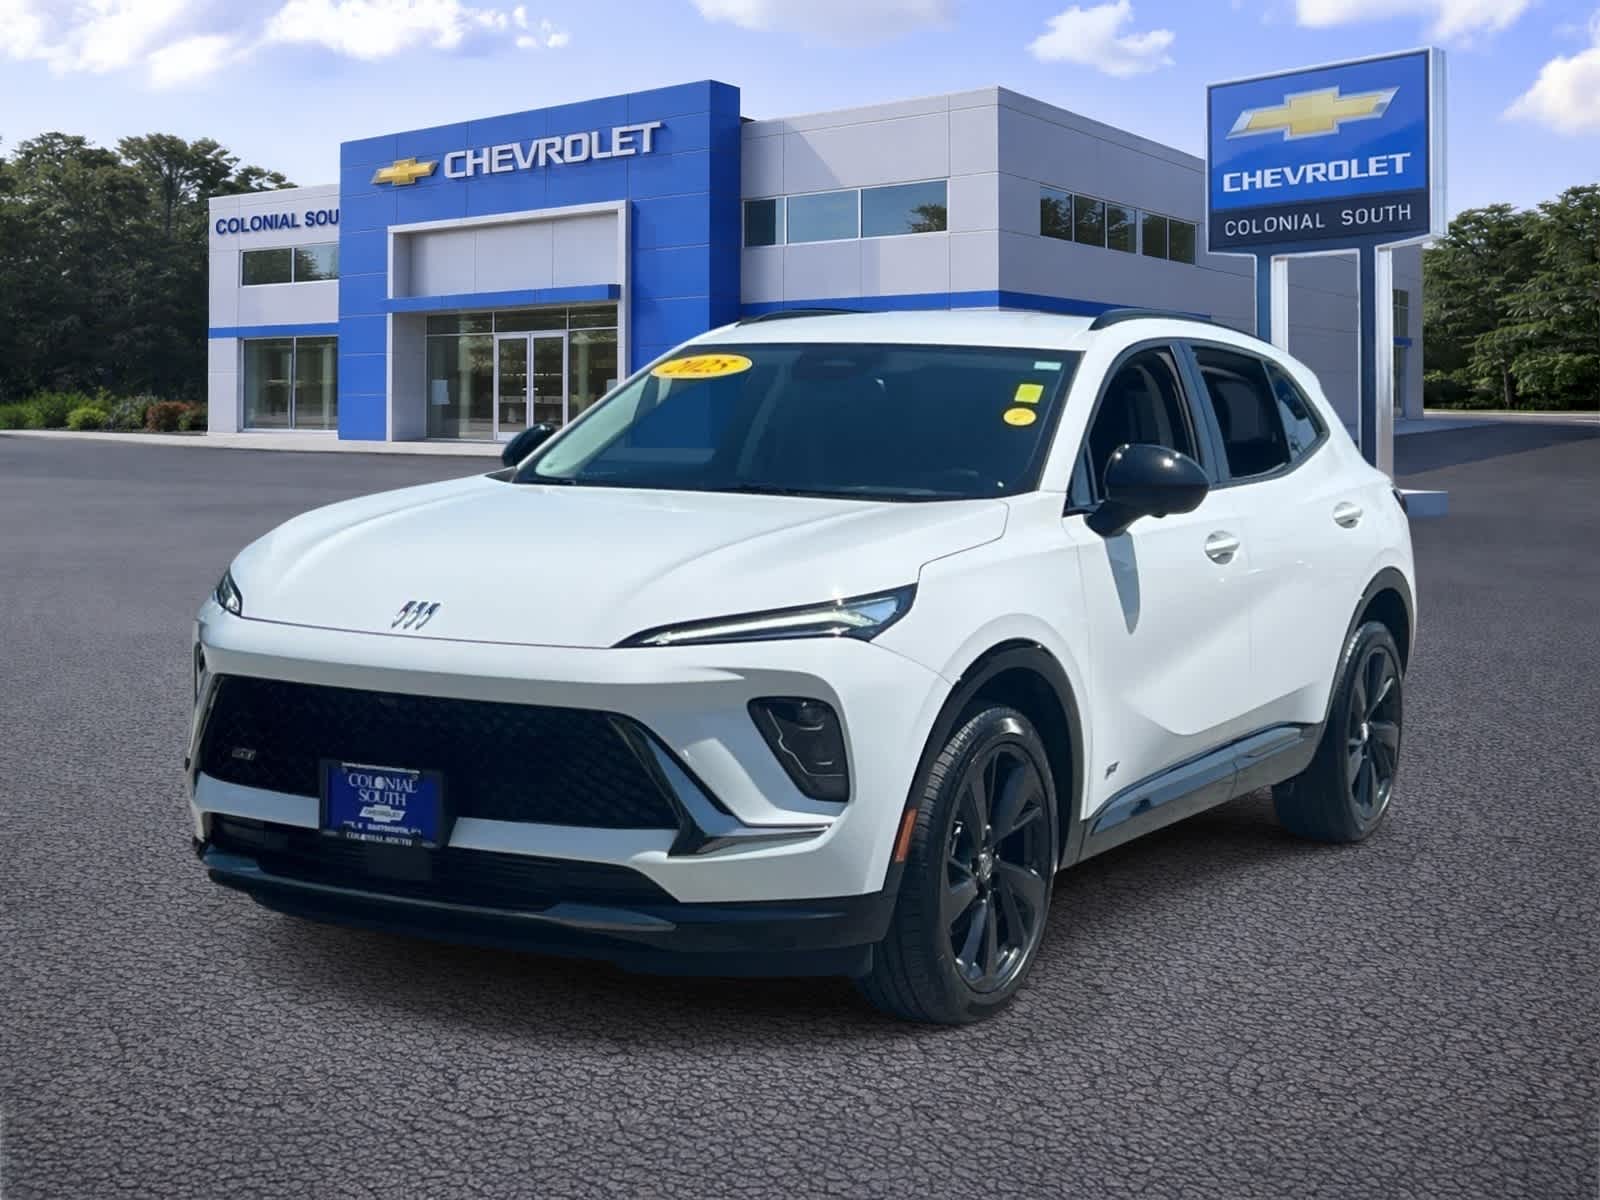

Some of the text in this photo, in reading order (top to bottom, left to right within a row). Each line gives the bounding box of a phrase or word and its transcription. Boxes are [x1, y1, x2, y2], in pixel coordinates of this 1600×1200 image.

[444, 121, 662, 179] CHEVROLET
[1223, 152, 1411, 192] CHEVROLET
[215, 212, 300, 235] COLONIAL
[1225, 204, 1412, 236] COLONIAL SOUTH
[348, 772, 418, 793] COLONIAL
[358, 788, 407, 806] SOUTH
